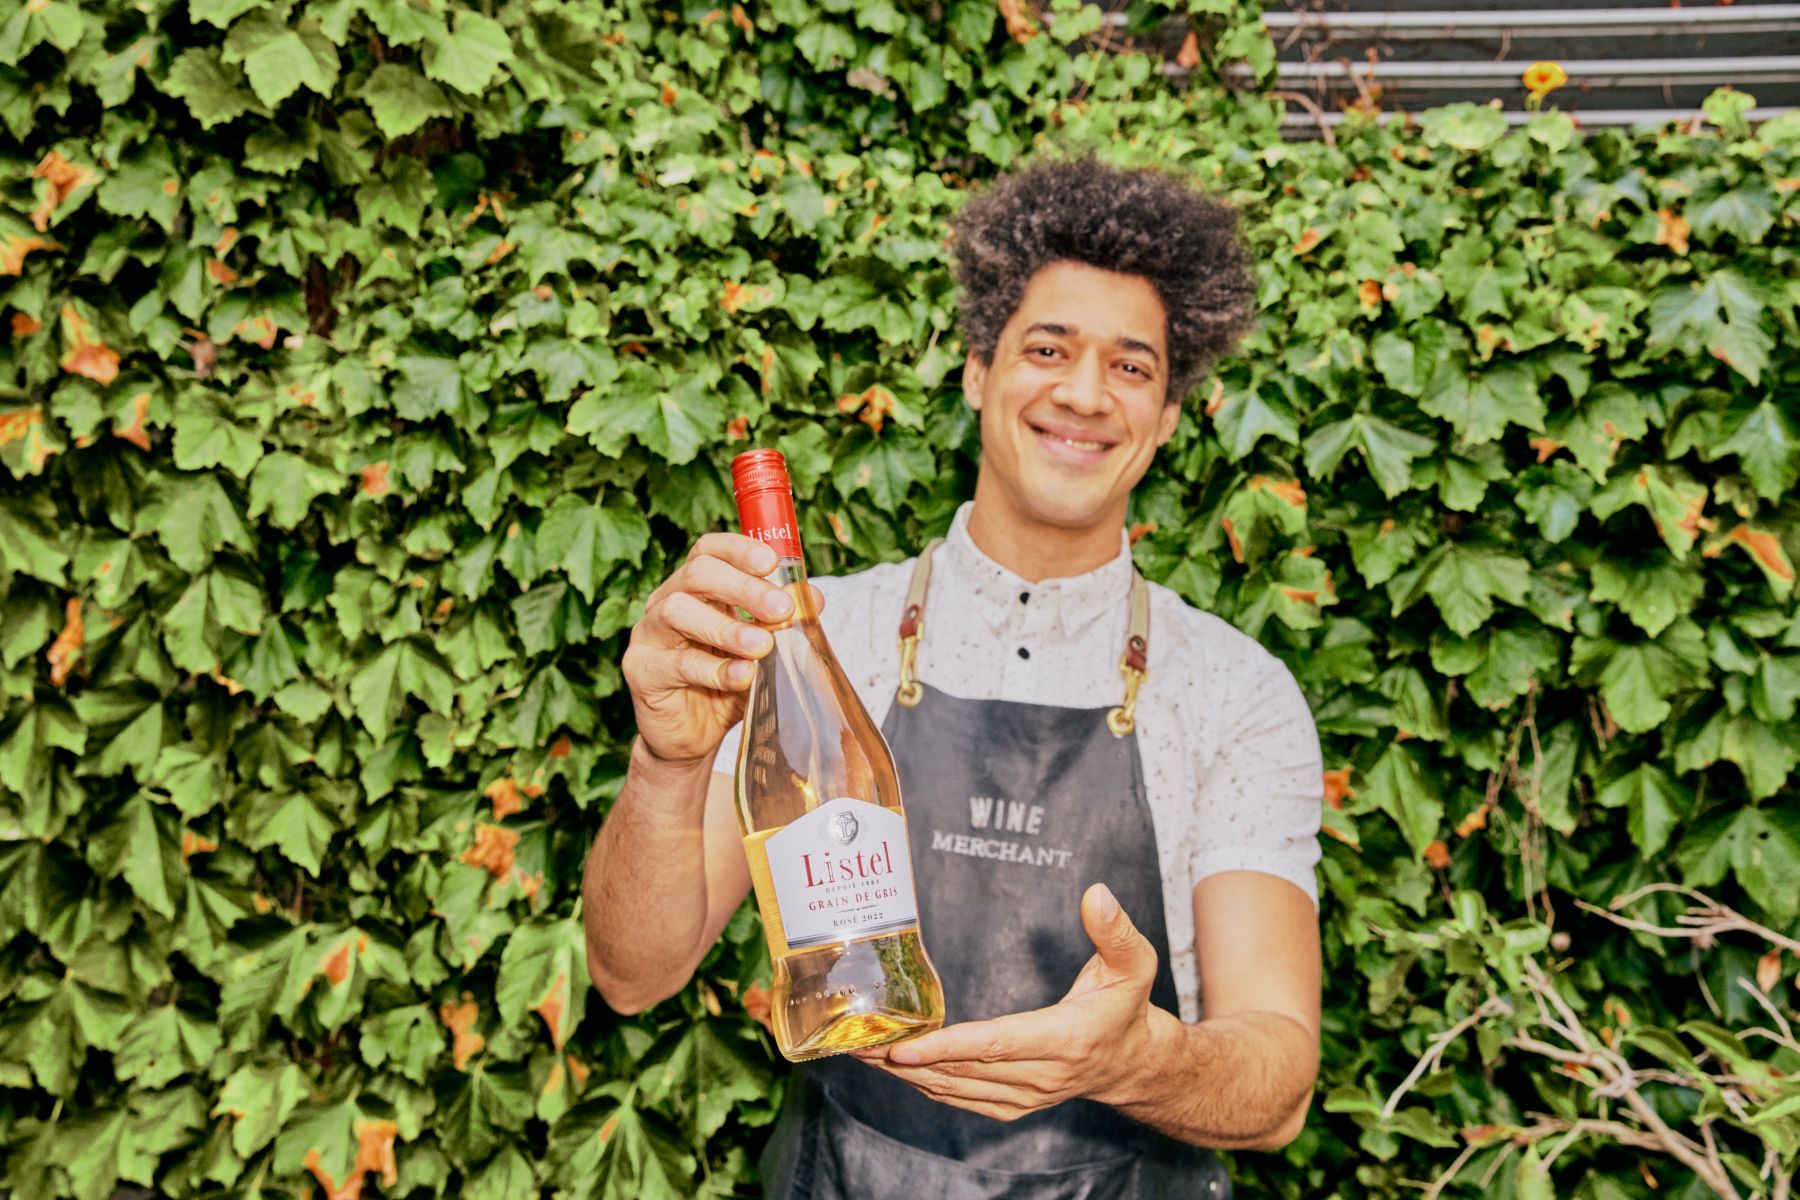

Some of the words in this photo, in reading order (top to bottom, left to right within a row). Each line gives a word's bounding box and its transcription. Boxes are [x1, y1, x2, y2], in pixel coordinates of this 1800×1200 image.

[969, 797, 1045, 834] WINE
[801, 841, 893, 887] Listel
[931, 830, 1072, 868] MERCHANT
[808, 896, 848, 911] GRAIN
[855, 893, 870, 902] DE
[875, 886, 898, 900] GRIS
[825, 882, 856, 893] DEPUIS
[862, 912, 883, 922] 2022
